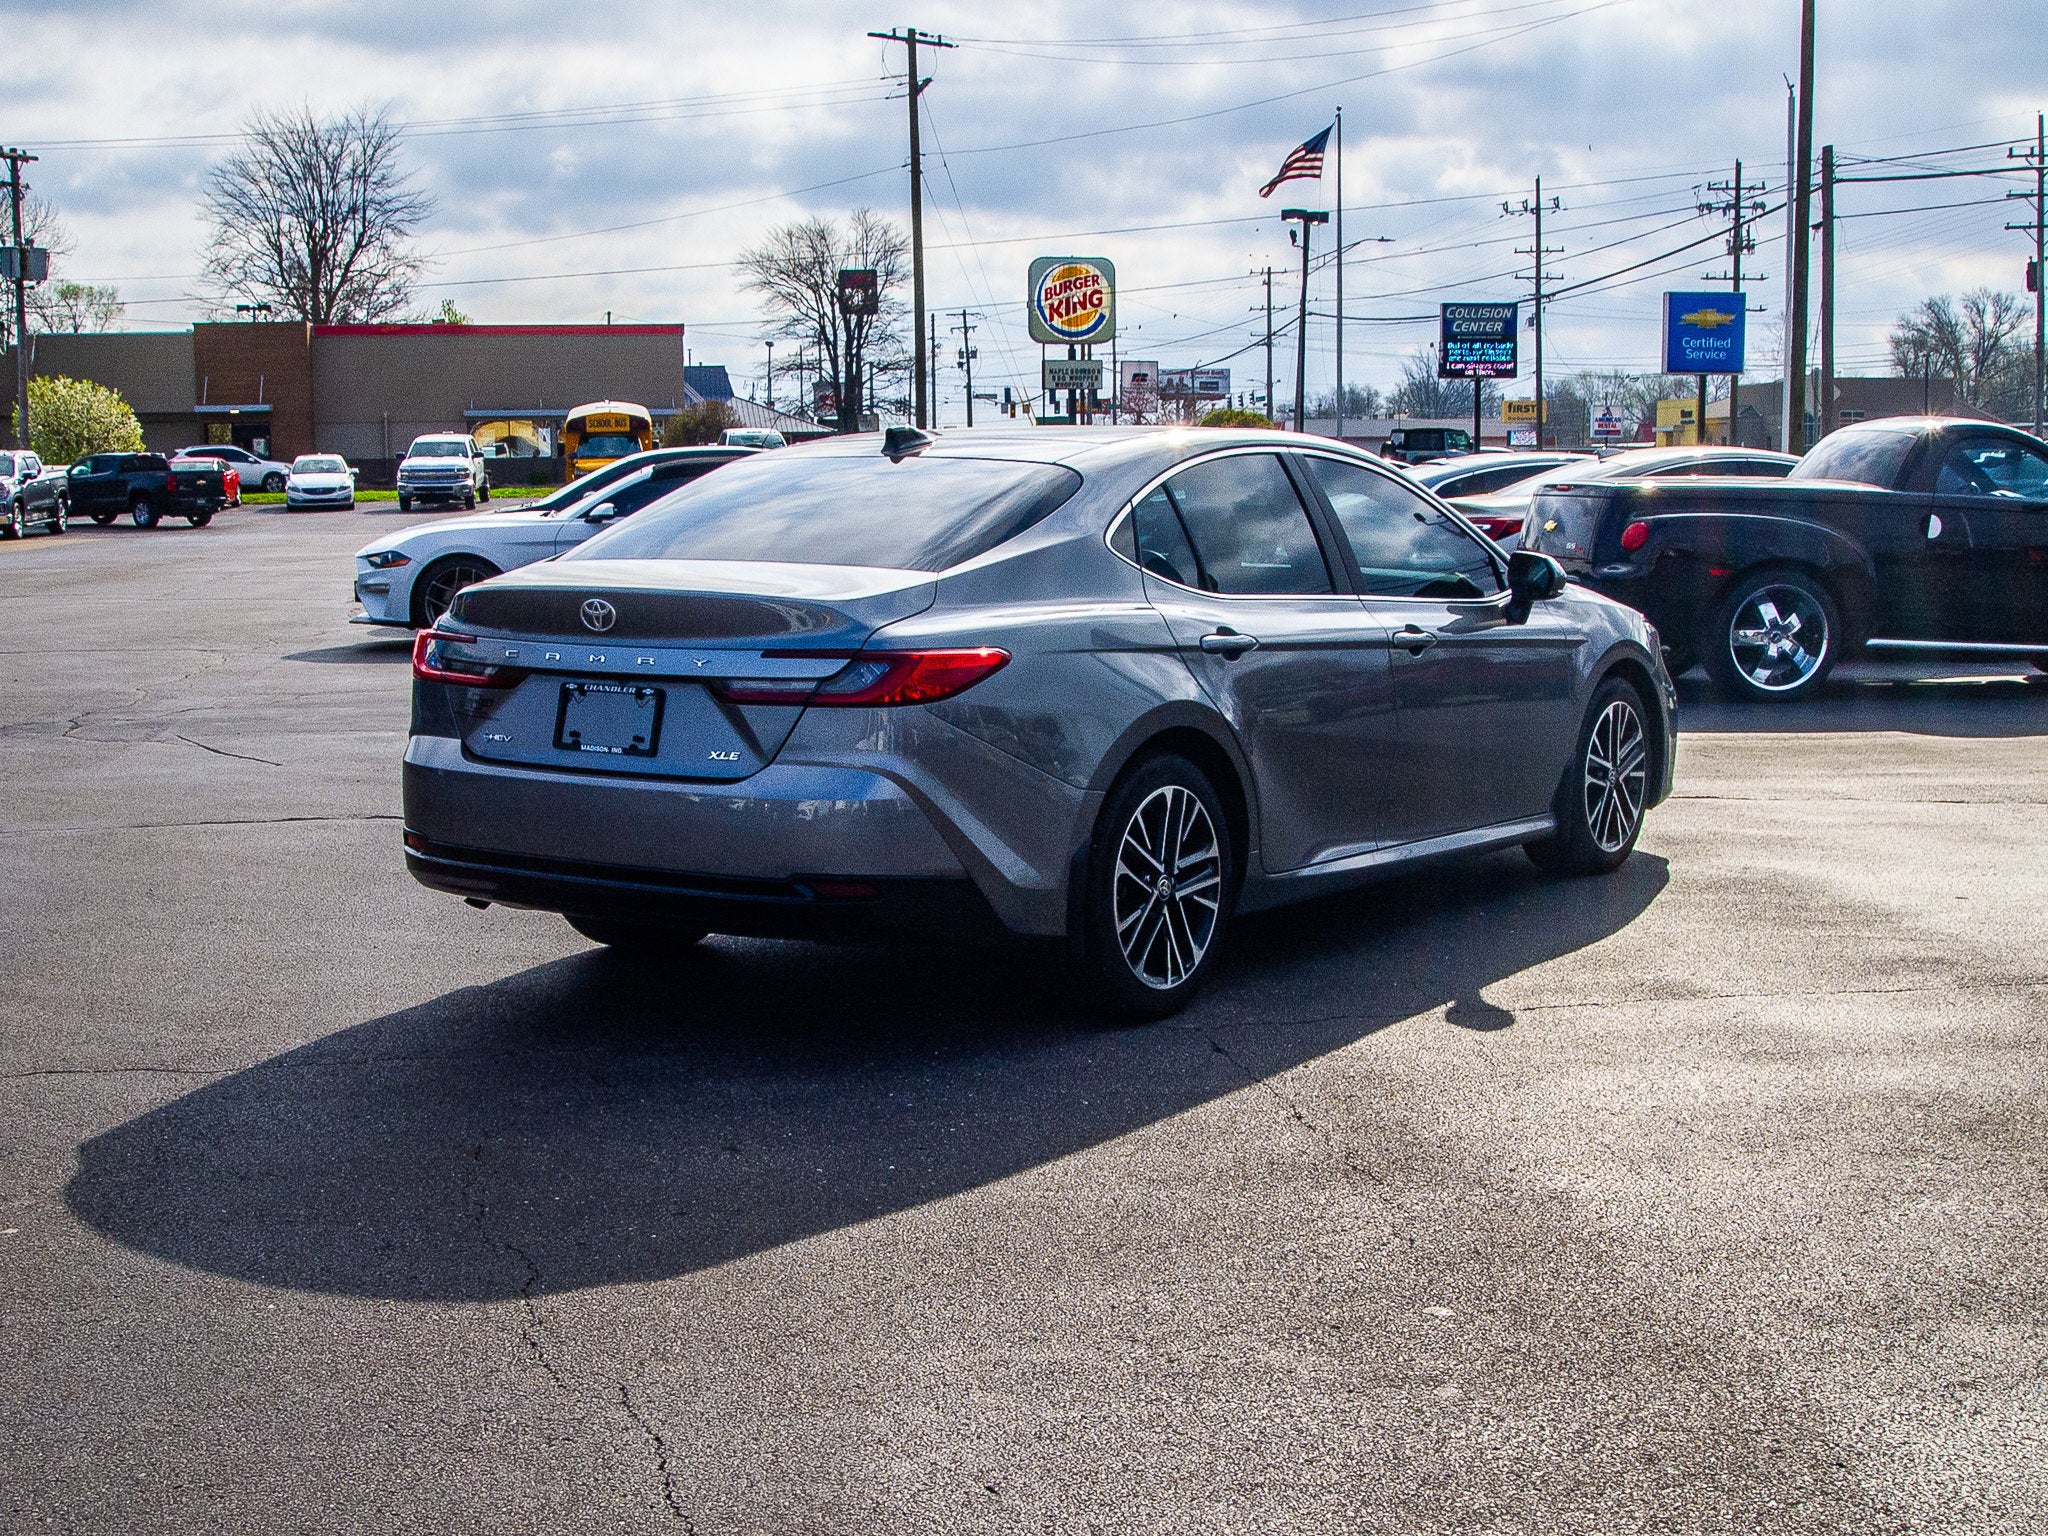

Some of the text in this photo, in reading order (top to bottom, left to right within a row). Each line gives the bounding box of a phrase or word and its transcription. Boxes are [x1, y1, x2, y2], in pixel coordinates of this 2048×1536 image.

[1044, 274, 1101, 302] BURGER
[1047, 289, 1104, 323] KING
[1446, 306, 1513, 319] COLLISION
[1452, 321, 1503, 333] CENTER
[1682, 337, 1731, 348] Certified
[1685, 348, 1727, 360] Service
[588, 418, 626, 428] SCHOOL BUS
[505, 649, 708, 667] CAMRY
[584, 684, 637, 694] CHANDLER
[708, 750, 741, 761] XLE
